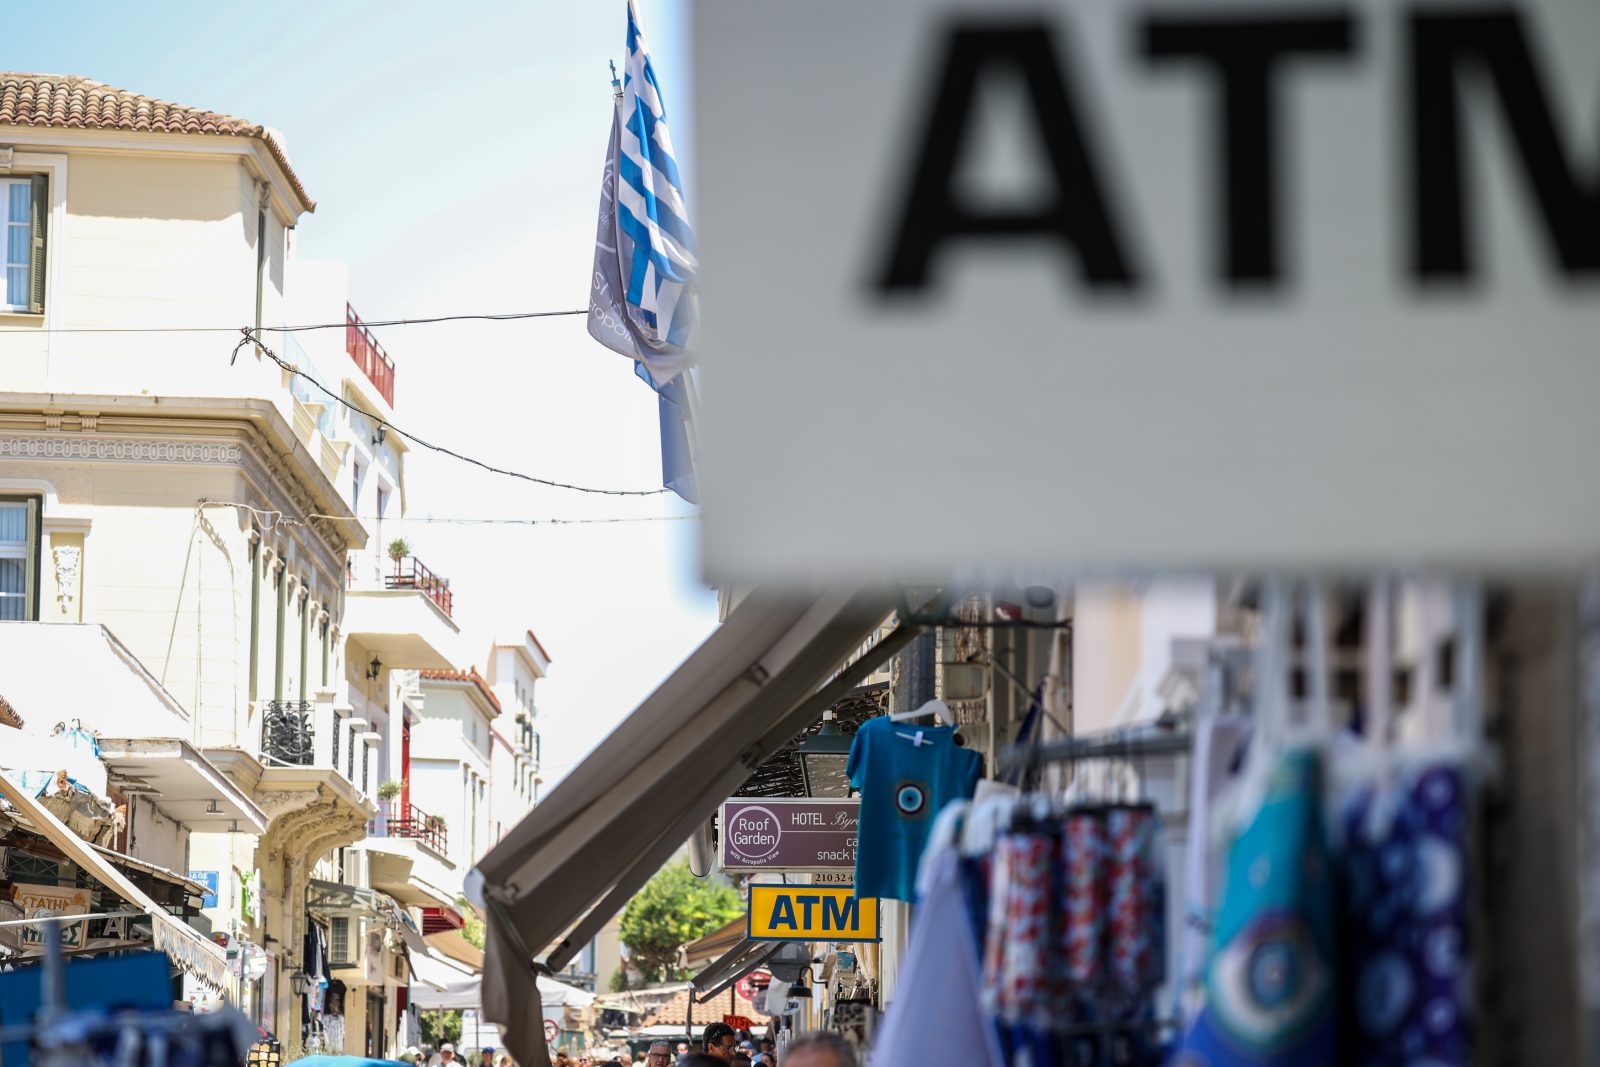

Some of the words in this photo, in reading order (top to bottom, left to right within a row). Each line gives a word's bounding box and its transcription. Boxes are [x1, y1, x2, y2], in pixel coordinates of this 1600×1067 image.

[739, 818, 769, 831] Roof
[791, 812, 826, 826] HOTEL
[734, 832, 775, 845] Garden
[846, 837, 859, 847] ca
[730, 850, 741, 861] with
[742, 858, 767, 866] Acropolis
[767, 850, 780, 861] View
[817, 849, 850, 860] snack
[852, 849, 858, 860] b
[815, 874, 833, 882] 210
[835, 874, 846, 882] 32
[768, 895, 860, 930] ATM
